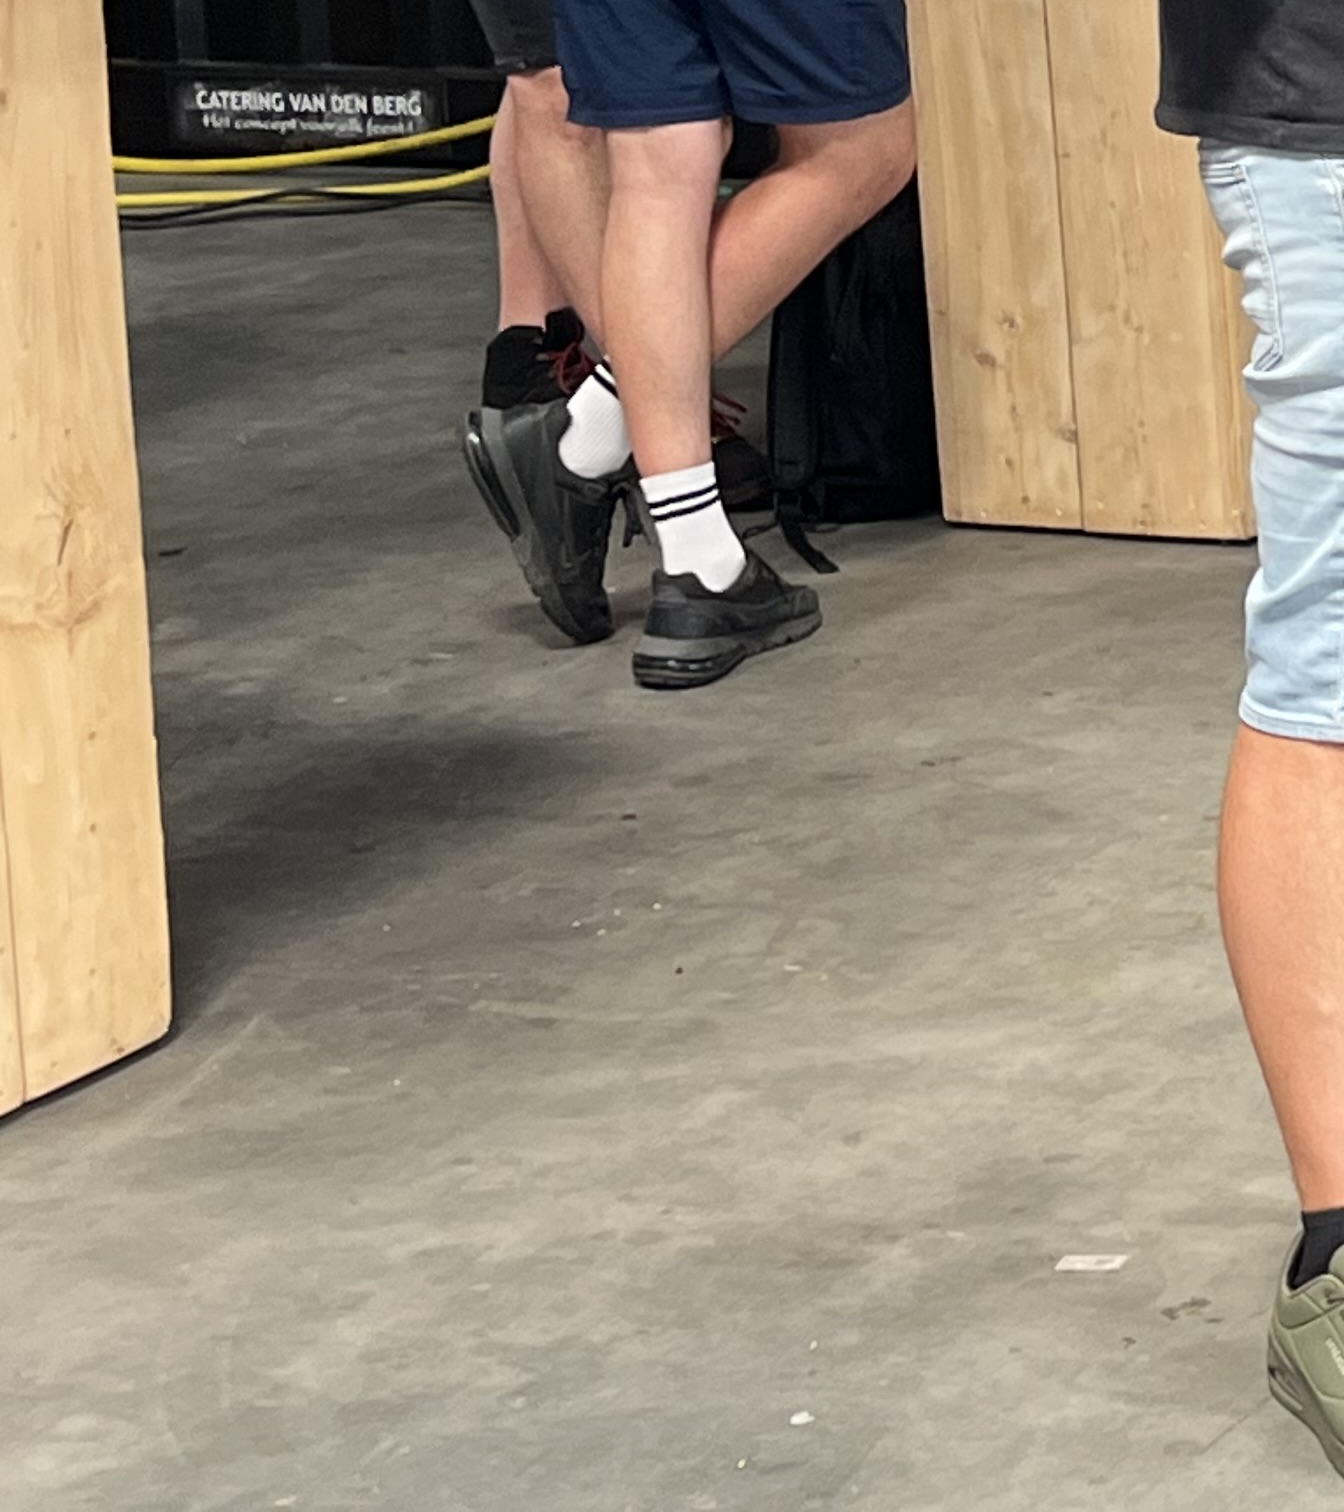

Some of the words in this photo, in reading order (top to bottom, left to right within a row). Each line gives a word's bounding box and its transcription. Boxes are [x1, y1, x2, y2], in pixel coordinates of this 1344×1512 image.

[196, 90, 285, 112] CATERING
[289, 92, 325, 113] VAN
[330, 93, 367, 115] DEN
[372, 92, 422, 116] BERG
